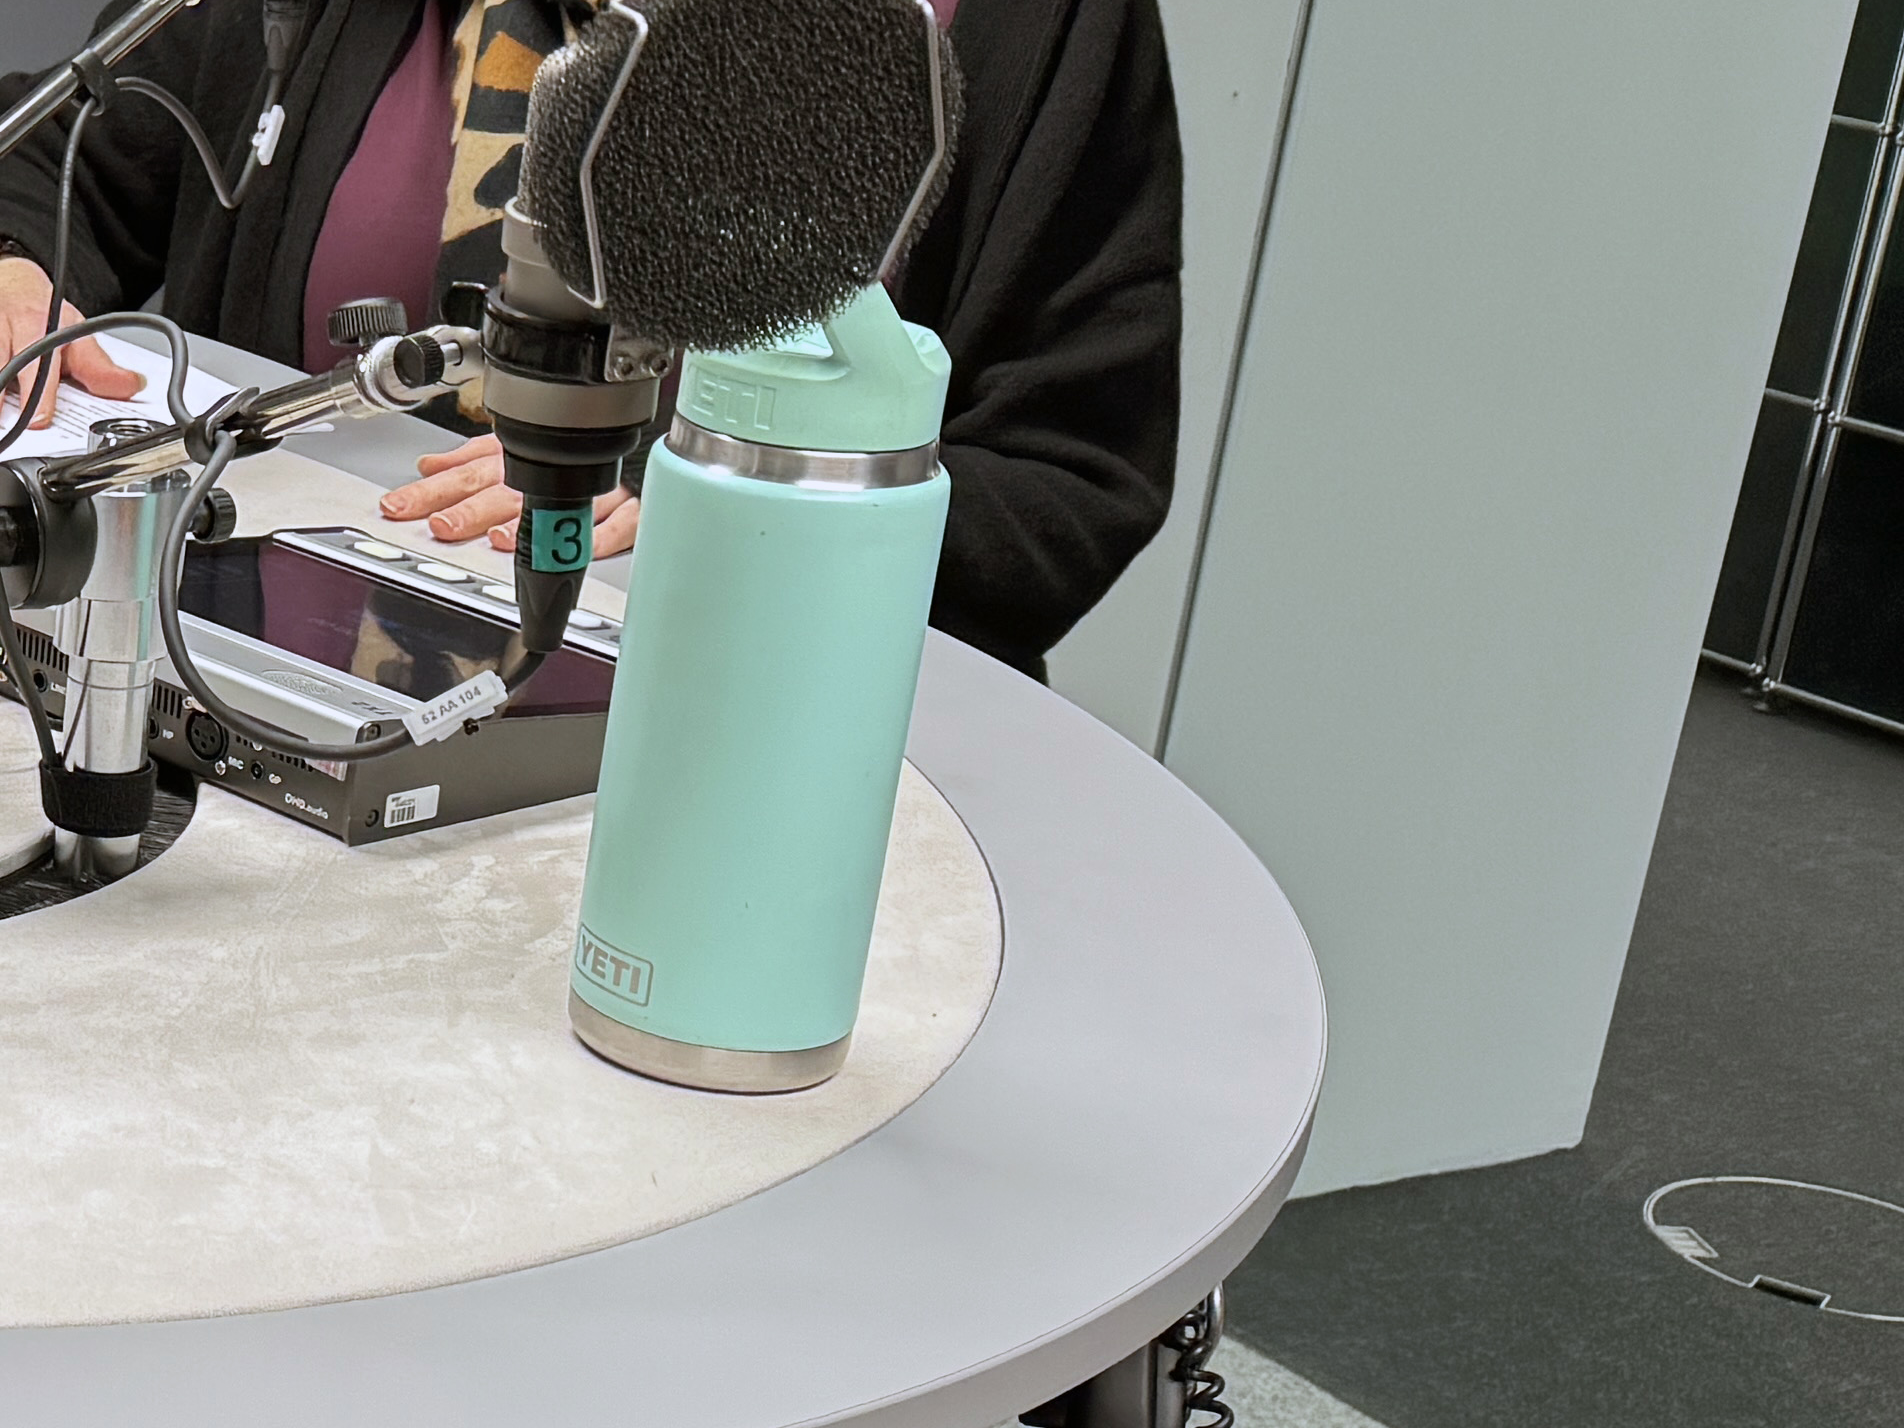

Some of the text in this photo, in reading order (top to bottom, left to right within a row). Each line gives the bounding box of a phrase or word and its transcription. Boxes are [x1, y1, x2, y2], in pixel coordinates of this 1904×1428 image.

[551, 517, 583, 565] 3
[421, 710, 438, 725] 62
[458, 685, 482, 704] 104
[580, 933, 642, 995] YETI
